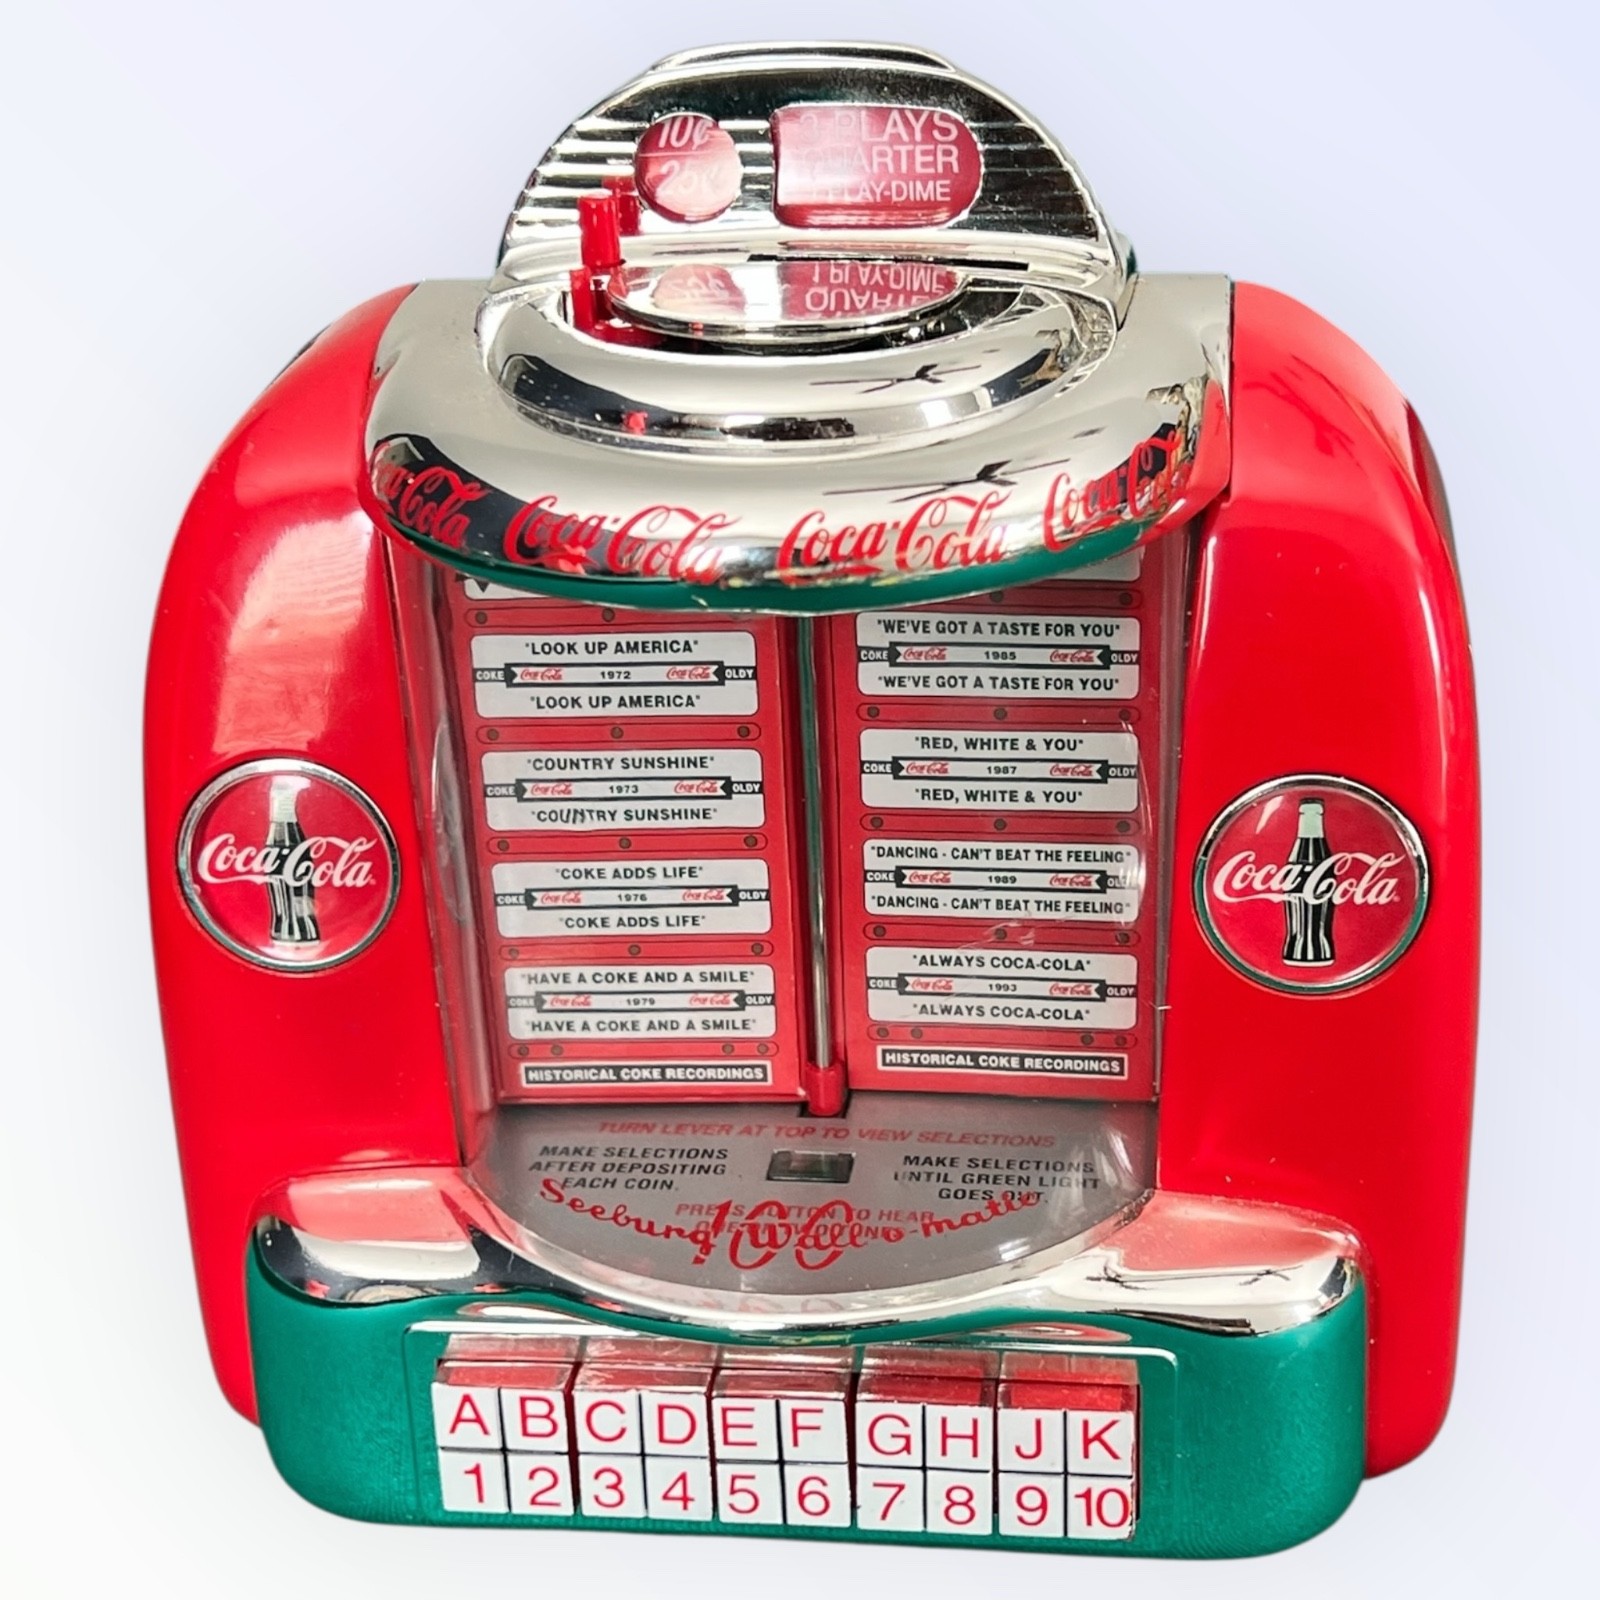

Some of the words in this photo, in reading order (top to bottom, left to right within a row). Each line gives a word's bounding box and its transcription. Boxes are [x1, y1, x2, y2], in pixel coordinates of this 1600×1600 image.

[834, 110, 958, 142] PLAYS
[776, 490, 1013, 586] Coca-Cola
[877, 619, 930, 634] "WE'VE
[936, 620, 967, 635] GOT
[973, 621, 983, 635] A
[988, 622, 1039, 636] TASTE
[1046, 623, 1075, 637] FOR
[1080, 624, 1120, 638] YOU"
[525, 641, 578, 656] "LOOK
[585, 642, 608, 654] UP
[614, 640, 699, 654] AMERICA"
[861, 650, 888, 661] COKE
[984, 651, 1016, 661] 1985
[1111, 653, 1137, 663] OLDY
[477, 671, 504, 681] COKE
[600, 671, 631, 680] 1972
[725, 669, 753, 679] OLDY
[878, 675, 930, 689] "WE'VE
[936, 676, 968, 689] GOT
[974, 676, 983, 689] A
[989, 676, 1039, 690] TASTE
[1044, 678, 1074, 690] FOR
[1079, 679, 1119, 692] YOU"
[530, 696, 582, 710] "LOOK
[589, 696, 611, 708] UP
[618, 695, 700, 708] AMERICA"
[915, 737, 958, 752] "RED,
[964, 738, 1019, 751] WHITE
[1025, 739, 1037, 751] &
[1043, 739, 1083, 752] YOU"
[527, 758, 615, 771] "COUNTRY
[621, 756, 714, 770] SUNSHINE"
[863, 763, 891, 773] COKE
[987, 766, 1017, 775] 1987
[1109, 767, 1136, 777] OLDY
[487, 786, 514, 796] COKE
[609, 785, 639, 794] 1973
[732, 783, 760, 793] OLDY
[915, 788, 959, 804] "RED,
[964, 789, 1019, 802] WHITE
[1025, 790, 1035, 802] &
[1042, 791, 1082, 804] YOU"
[532, 809, 617, 824] "COUNTRY
[624, 807, 717, 821] SUNSHINE"
[198, 833, 377, 887] Coca-Cola
[871, 845, 938, 860] "DANCING
[951, 848, 991, 861] CAN'T
[996, 849, 1030, 862] BEAT
[1035, 850, 1062, 863] THE
[1067, 850, 1130, 864] FEELING"
[555, 868, 606, 880] "COKE
[612, 868, 657, 879] ADDS
[663, 866, 703, 878] LIFE"
[867, 872, 894, 881] COKE
[988, 875, 1017, 885] 1989
[1213, 851, 1405, 905] Coca-Cola
[497, 895, 524, 905] COKE
[618, 893, 647, 902] 1976
[739, 890, 766, 900] OLDY
[871, 895, 939, 910] "DANCING
[951, 897, 991, 911] CAN'T
[996, 898, 1030, 912] BEAT
[1034, 900, 1061, 913] THE
[1065, 900, 1130, 914] FEELING"
[559, 916, 610, 929] "COKE
[617, 916, 659, 928] ADDS
[666, 916, 705, 927] LIFE"
[913, 954, 984, 968] "ALWAYS
[990, 956, 1091, 972] COCA-COLA"
[521, 972, 571, 985] "HAVE
[578, 972, 587, 984] A
[592, 972, 638, 984] COKE
[644, 972, 678, 984] AND
[684, 972, 694, 983] A
[699, 971, 754, 983] SMILE"
[869, 979, 896, 989] COKE
[988, 983, 1017, 993] 1993
[1107, 986, 1133, 996] OLDY
[746, 995, 772, 1005] OLDY
[913, 1003, 985, 1017] "ALWAYS
[990, 1005, 1090, 1021] COCA-COLA"
[526, 1020, 575, 1033] "HAVE
[581, 1020, 591, 1031] A
[596, 1020, 640, 1032] COKE
[647, 1020, 680, 1031] AND
[686, 1020, 695, 1031] A
[700, 1019, 756, 1031] SMILE"
[885, 1051, 974, 1067] HISTORICAL
[979, 1055, 1020, 1069] COKE
[1024, 1056, 1120, 1073] RECORDINGS
[528, 1067, 617, 1082] HISTORICAL
[620, 1067, 662, 1081] COKE
[666, 1066, 763, 1081] RECORDINGS
[600, 1122, 656, 1134] TURN
[662, 1123, 732, 1136] LEVER
[738, 1125, 767, 1136] AT
[774, 1125, 816, 1138] TOP
[820, 1127, 849, 1139] TO
[859, 1129, 912, 1141] VIEW
[917, 1131, 1055, 1147] SELECTIONS
[540, 1145, 599, 1157] MAKE
[603, 1147, 728, 1160] SELECTIONS
[529, 1161, 596, 1173] AFTER
[601, 1162, 726, 1176] DEPOSITING
[903, 1155, 960, 1168] MAKE
[967, 1157, 1094, 1173] SELECTIONS
[562, 1177, 617, 1190] EACH
[625, 1177, 679, 1191] COIN.
[962, 1173, 1030, 1186] GREEN
[1039, 1176, 1099, 1189] LIGHT
[939, 1188, 993, 1200] GOES
[675, 1203, 745, 1217] PRES
[449, 1394, 490, 1436] A
[519, 1397, 558, 1437] B
[585, 1402, 628, 1442] C
[658, 1404, 697, 1444] D
[722, 1407, 756, 1447] E
[791, 1408, 823, 1447] F
[868, 1414, 912, 1455] G
[941, 1418, 979, 1457] H
[1015, 1418, 1044, 1459] J
[1081, 1420, 1120, 1460] K
[465, 1465, 483, 1503] 1
[529, 1466, 562, 1506] 2
[593, 1469, 625, 1508] 3
[662, 1471, 696, 1511] 4
[728, 1474, 760, 1514] 5
[796, 1476, 830, 1516] 6
[873, 1483, 905, 1521] 7
[945, 1486, 975, 1525] 8
[1017, 1486, 1047, 1526] 9
[1075, 1487, 1128, 1527] 10
